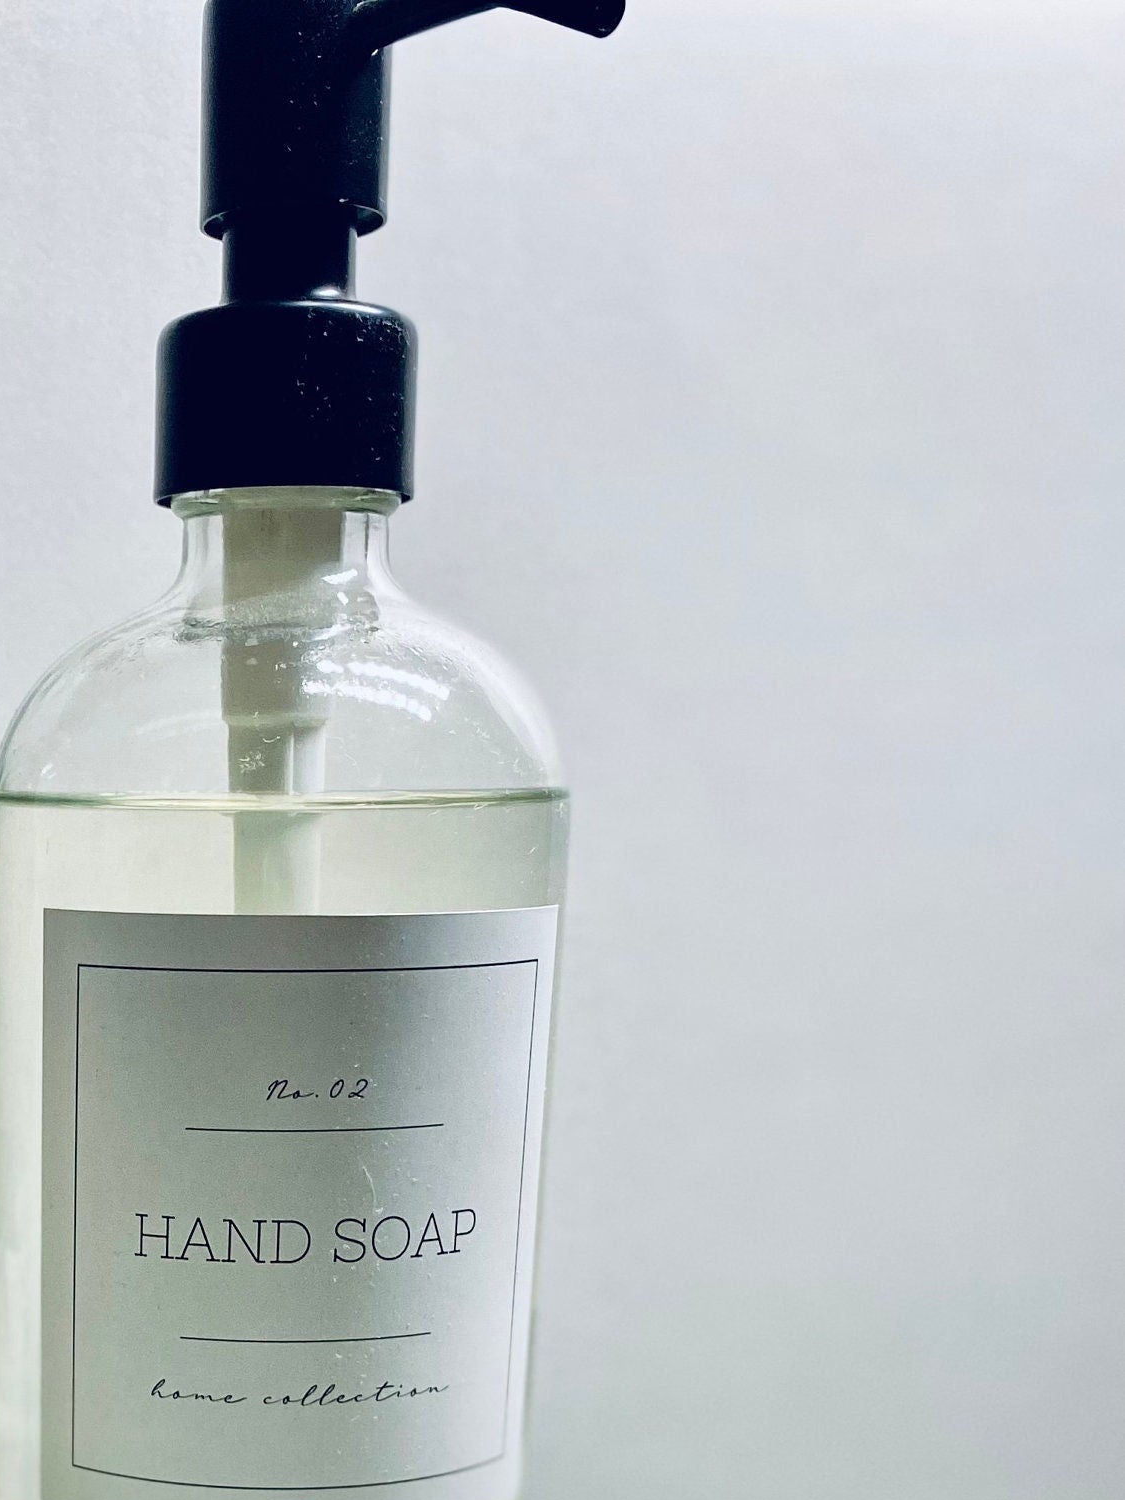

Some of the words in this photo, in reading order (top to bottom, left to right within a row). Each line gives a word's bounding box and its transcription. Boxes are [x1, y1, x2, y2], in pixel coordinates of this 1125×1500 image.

[265, 1079, 319, 1102] No.
[329, 1078, 369, 1100] 02
[133, 1212, 312, 1265] HAND
[332, 1208, 477, 1264] SOAP
[150, 1378, 248, 1404] home
[262, 1380, 450, 1407] collection
